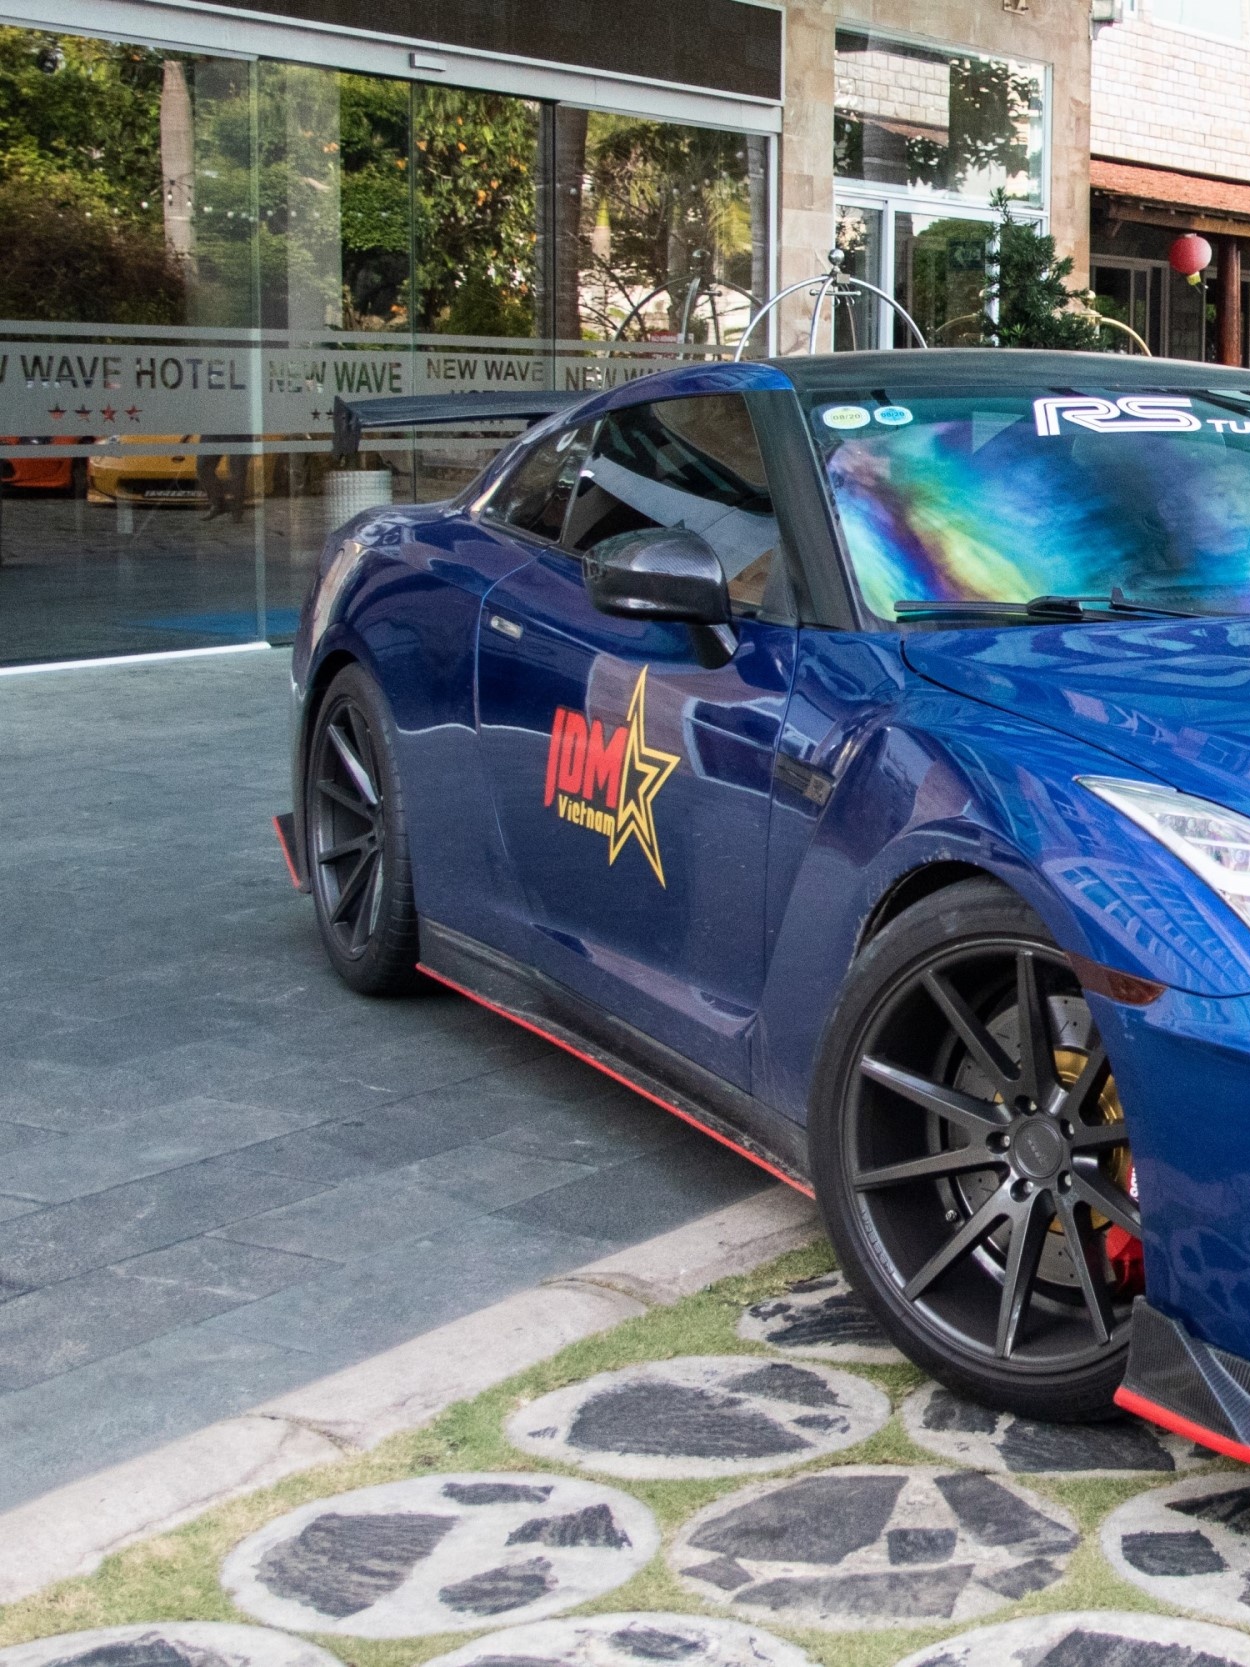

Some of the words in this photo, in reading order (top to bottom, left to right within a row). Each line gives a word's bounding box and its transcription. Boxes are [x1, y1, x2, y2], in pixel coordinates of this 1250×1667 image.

[20, 355, 121, 389] WAVE
[135, 357, 247, 390] HOTEL
[269, 360, 326, 393] NEW
[334, 361, 402, 393] WAVE
[426, 358, 477, 380] NEW
[484, 360, 544, 381] WAVE
[1034, 396, 1202, 436] RS
[544, 706, 628, 809] JDM
[558, 794, 616, 837] Vietnam
